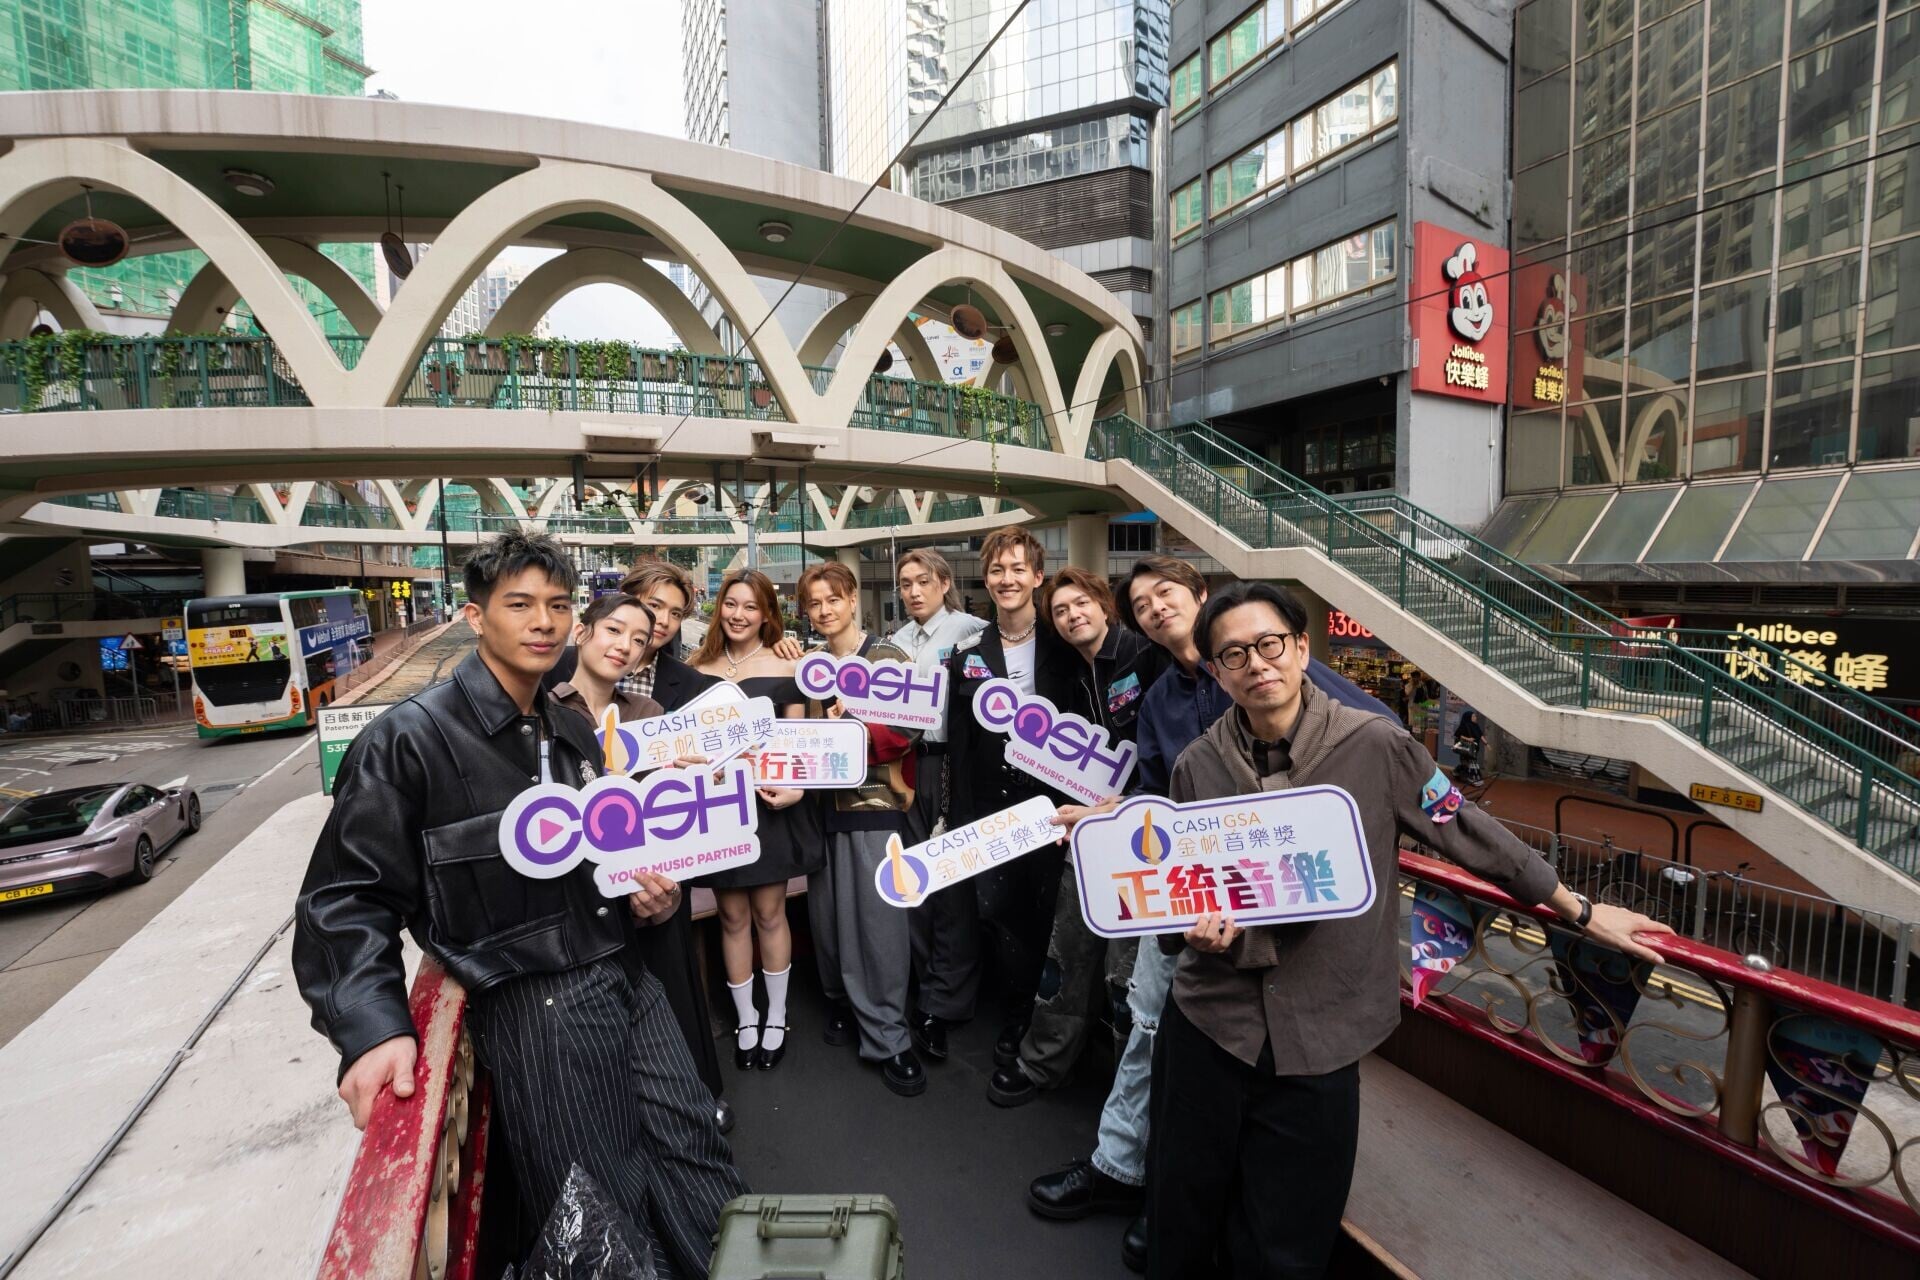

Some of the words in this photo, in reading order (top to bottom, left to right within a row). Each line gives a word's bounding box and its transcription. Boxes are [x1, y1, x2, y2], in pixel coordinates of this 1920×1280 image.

[1451, 343, 1485, 363] Jollibee
[1446, 358, 1489, 390] 快樂蜂
[1727, 622, 1838, 646] Jollibee
[801, 658, 941, 707] CASH
[1724, 646, 1889, 692] 快樂蜂
[324, 711, 376, 724] 百德新街
[325, 724, 359, 732] Paterson
[641, 713, 697, 737] CASH
[700, 705, 741, 725] GSA
[777, 727, 797, 736] ASH
[798, 727, 818, 736] GSA
[847, 708, 868, 717] OUR
[869, 710, 895, 720] MUSIC
[897, 713, 936, 724] PARTNER
[647, 717, 776, 765] 金帆音樂獎
[980, 685, 1133, 788] CASH
[1011, 749, 1036, 767] YOUR
[1036, 763, 1065, 783] MUSIC
[1065, 778, 1105, 805] PARTNE
[514, 769, 749, 866] CASH
[1172, 816, 1220, 834] CASH
[1223, 811, 1262, 828] GSA
[925, 827, 979, 858] CASH
[979, 811, 1021, 836] GSA
[935, 815, 1062, 885] 金帆音樂獎
[1177, 824, 1297, 858] 金帆音樂獎
[651, 856, 694, 875] MUSIC
[697, 843, 752, 865] PARTNER
[5, 891, 21, 900] CB
[25, 886, 44, 896] 129
[1111, 849, 1340, 921] 正統音樂
